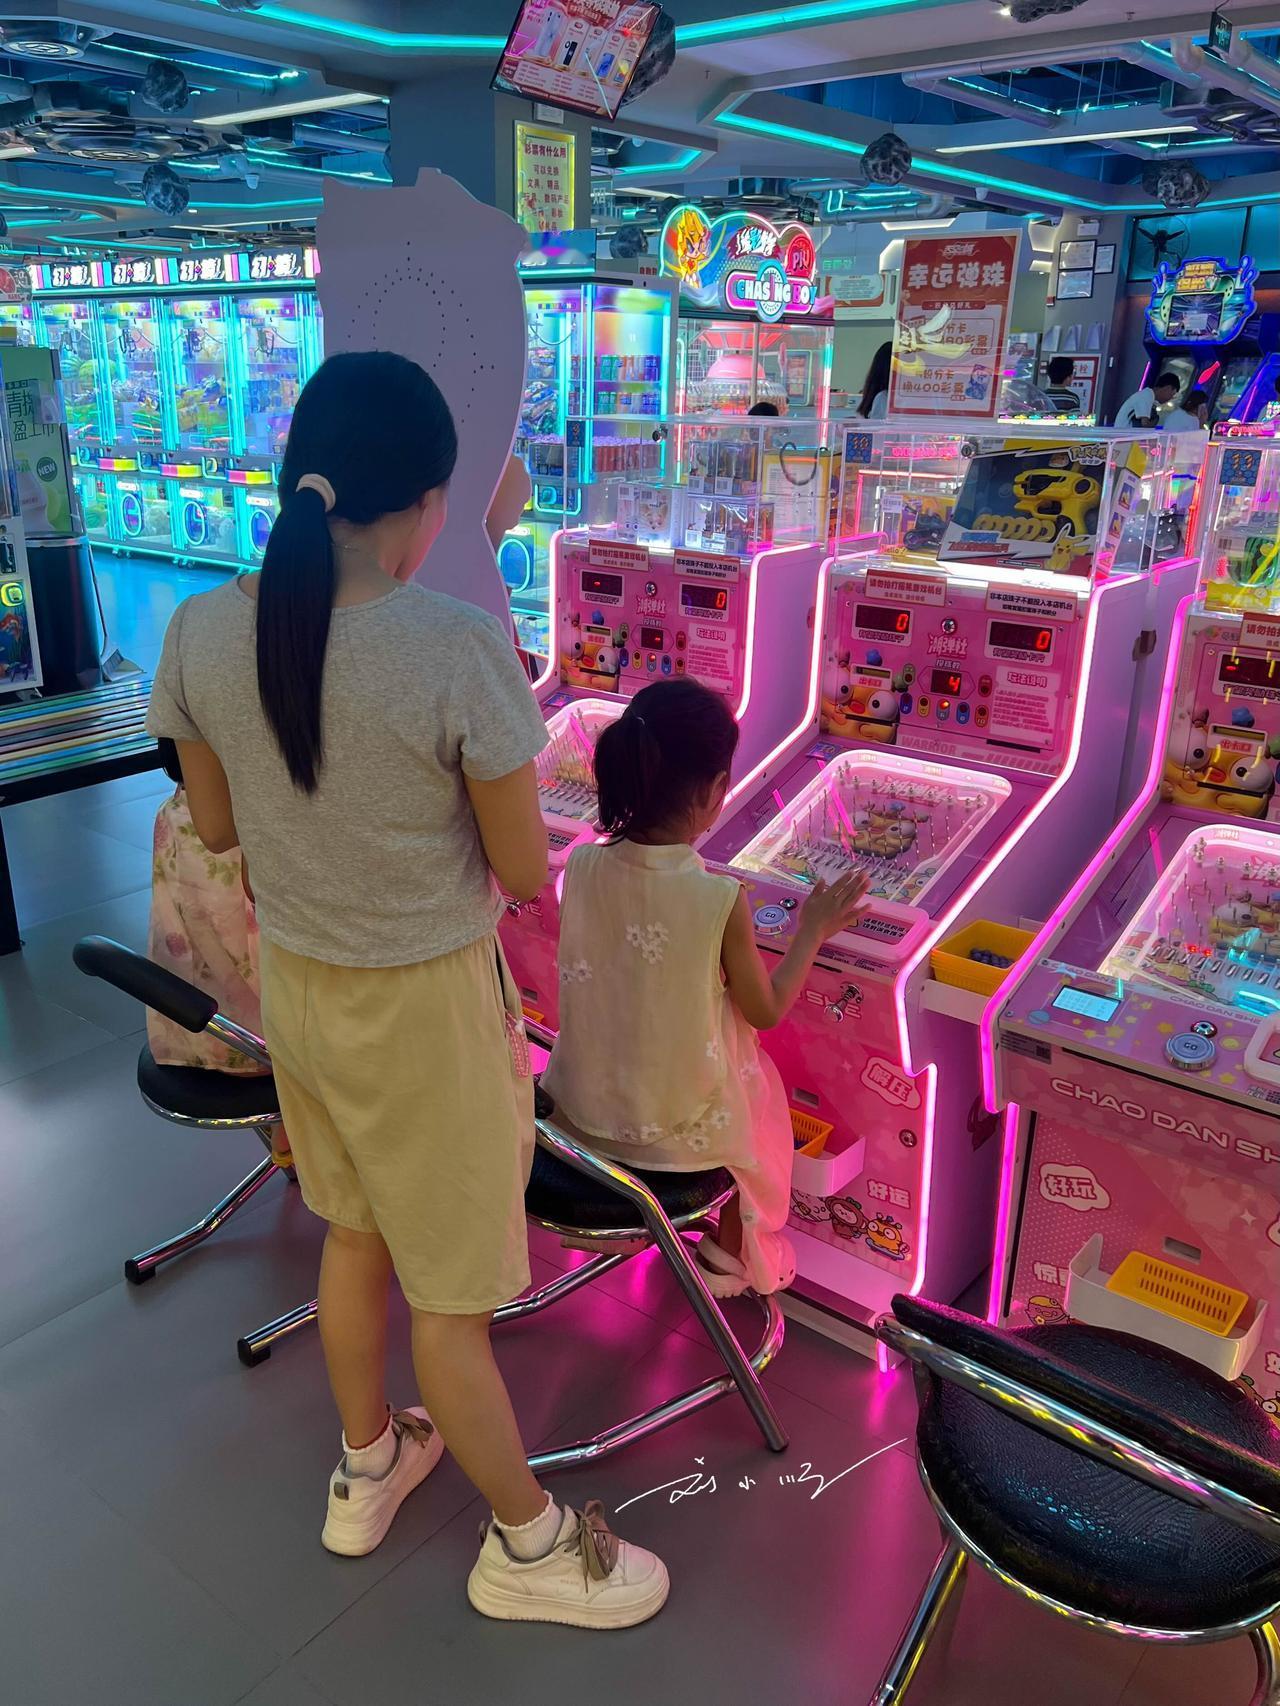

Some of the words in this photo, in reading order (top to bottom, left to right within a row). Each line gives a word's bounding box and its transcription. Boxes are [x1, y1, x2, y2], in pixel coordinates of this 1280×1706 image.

[908, 261, 1006, 289] 幸运弹珠
[736, 274, 791, 303] CHASING
[792, 284, 818, 305] BOY
[38, 463, 56, 477] NEW
[715, 592, 727, 609] 0
[895, 613, 909, 632] 0
[1035, 631, 1051, 650] 0
[948, 676, 960, 692] 4
[1007, 670, 1048, 688] 玩法说明
[901, 735, 957, 755] WARRIOR
[765, 911, 776, 919] GO
[1169, 996, 1206, 1011] CHAO
[1207, 1004, 1237, 1018] DAN
[1183, 1041, 1198, 1051] GO
[869, 1064, 913, 1099] 解压
[1052, 1078, 1146, 1120] CHAO
[1152, 1110, 1228, 1149] DAN
[1236, 1138, 1280, 1163] SH
[867, 1180, 912, 1209] 好运
[1045, 1174, 1097, 1201] 好玩
